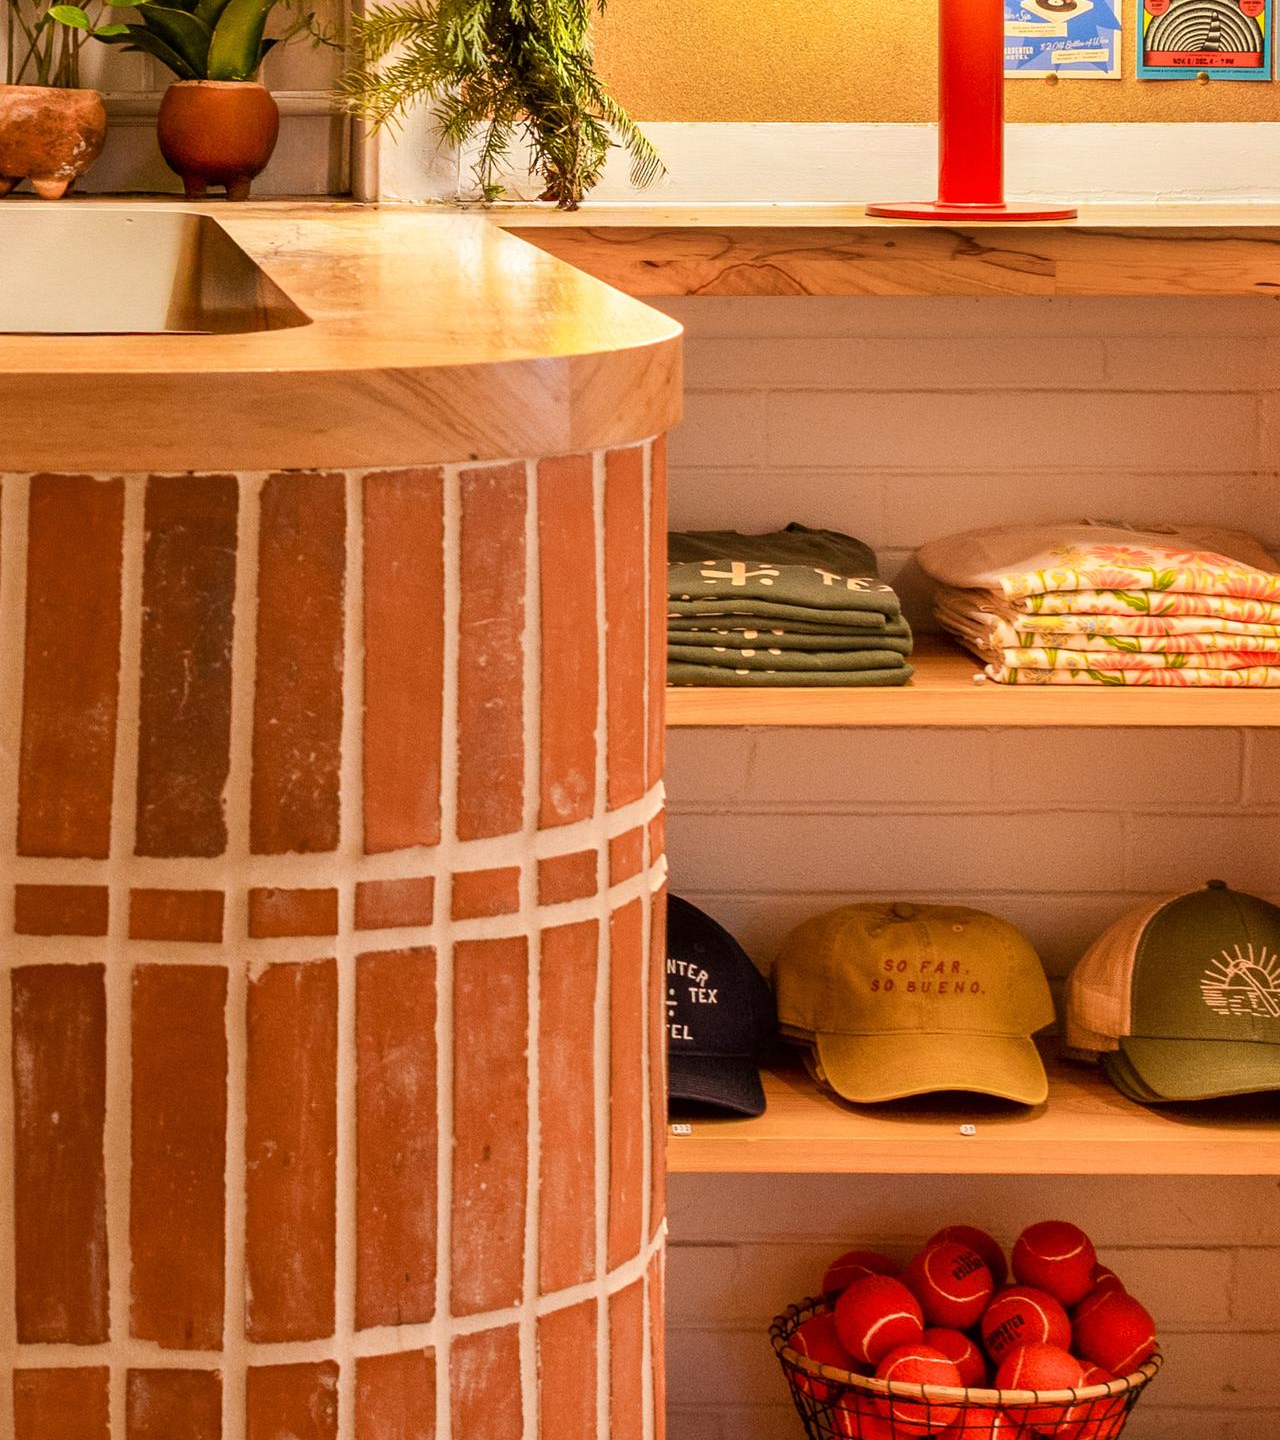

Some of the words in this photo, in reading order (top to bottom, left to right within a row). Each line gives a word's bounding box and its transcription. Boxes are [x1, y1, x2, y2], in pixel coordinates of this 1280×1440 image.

[883, 958, 908, 973] SO
[919, 960, 969, 975] FAR.
[687, 986, 719, 1004] TEX
[871, 979, 895, 993] SO
[906, 980, 986, 995] BUENO.
